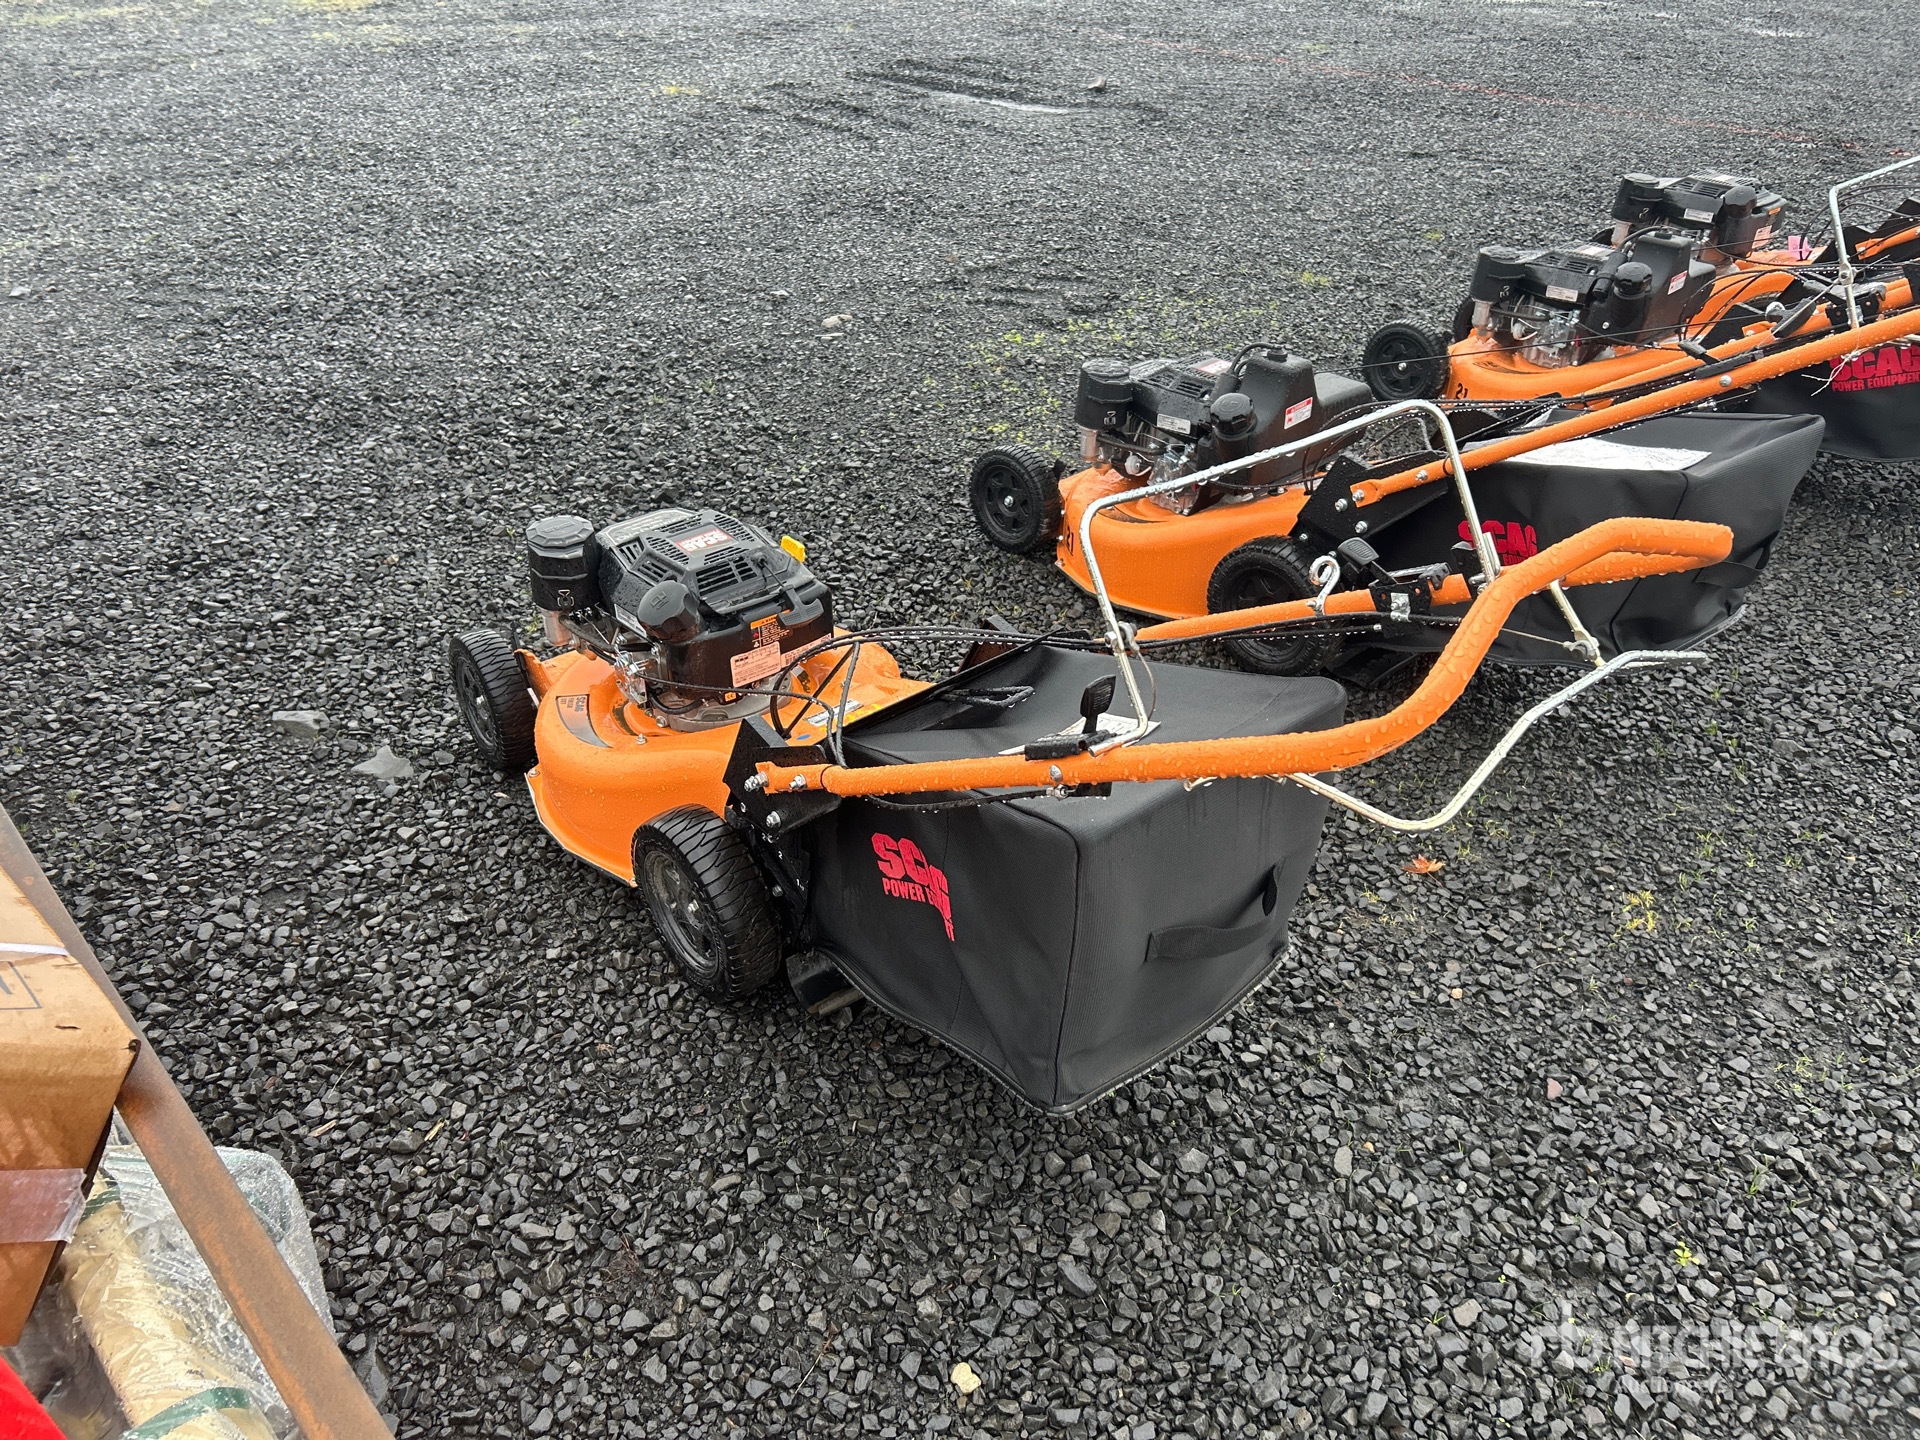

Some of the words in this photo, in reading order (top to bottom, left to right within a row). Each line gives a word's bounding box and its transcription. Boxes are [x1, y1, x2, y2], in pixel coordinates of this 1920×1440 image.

[1832, 380, 1865, 392] POWER
[871, 832, 950, 915] SCG
[882, 877, 926, 903] POWER
